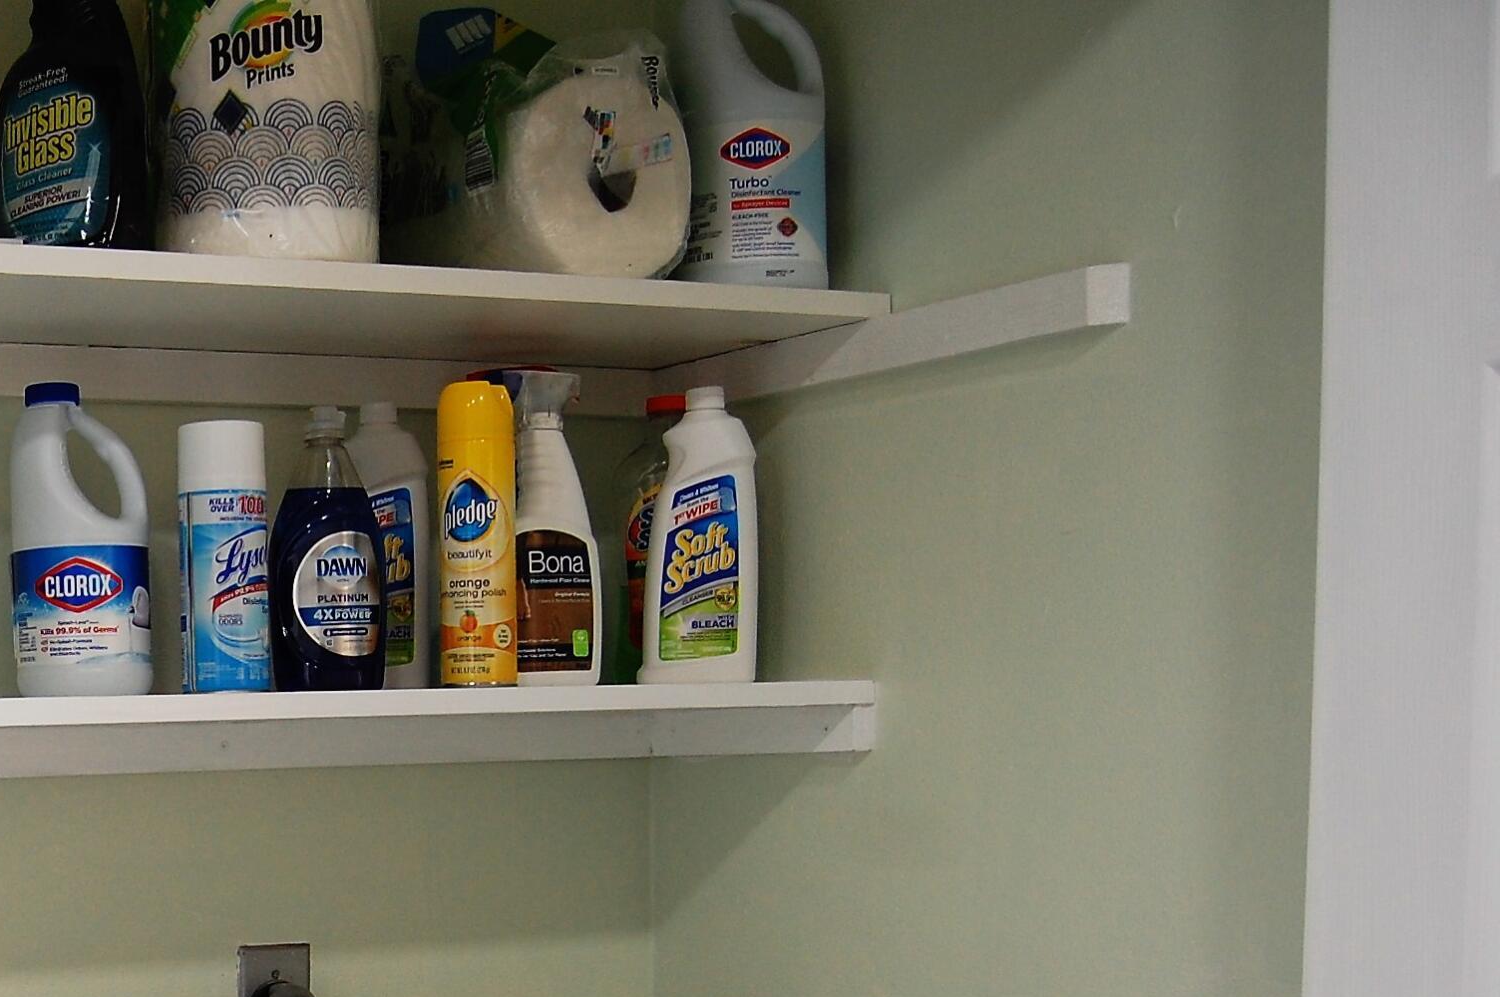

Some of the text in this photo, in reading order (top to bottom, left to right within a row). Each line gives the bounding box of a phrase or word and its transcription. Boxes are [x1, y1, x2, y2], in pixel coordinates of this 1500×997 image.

[210, 9, 323, 82] Bounty
[19, 66, 67, 89] Streak-Free
[246, 62, 295, 89] Prints
[17, 75, 68, 98] Guaranteed!
[4, 92, 95, 152] Invisible
[16, 130, 76, 176] Glass
[729, 140, 783, 159] CLOROX
[38, 167, 73, 184] Cleaner
[729, 177, 770, 190] Turbo
[24, 185, 63, 203] SUPERIOR
[10, 189, 81, 219] CLEANING POWER!
[211, 505, 234, 513] OVER
[684, 500, 718, 520] WIPE
[444, 499, 498, 540] pledge
[672, 521, 729, 562] Soft
[447, 549, 492, 560] beautify it
[528, 550, 585, 574] Bona
[316, 558, 367, 577] DAWN
[664, 541, 735, 594] Scrub
[44, 574, 112, 598] CLOROX
[449, 579, 490, 589] orange
[481, 589, 506, 598] polish
[317, 594, 369, 603] PLATINUM
[313, 608, 372, 621] 4X POWER
[692, 619, 734, 629] BLEACH
[55, 627, 81, 635] 99.9%
